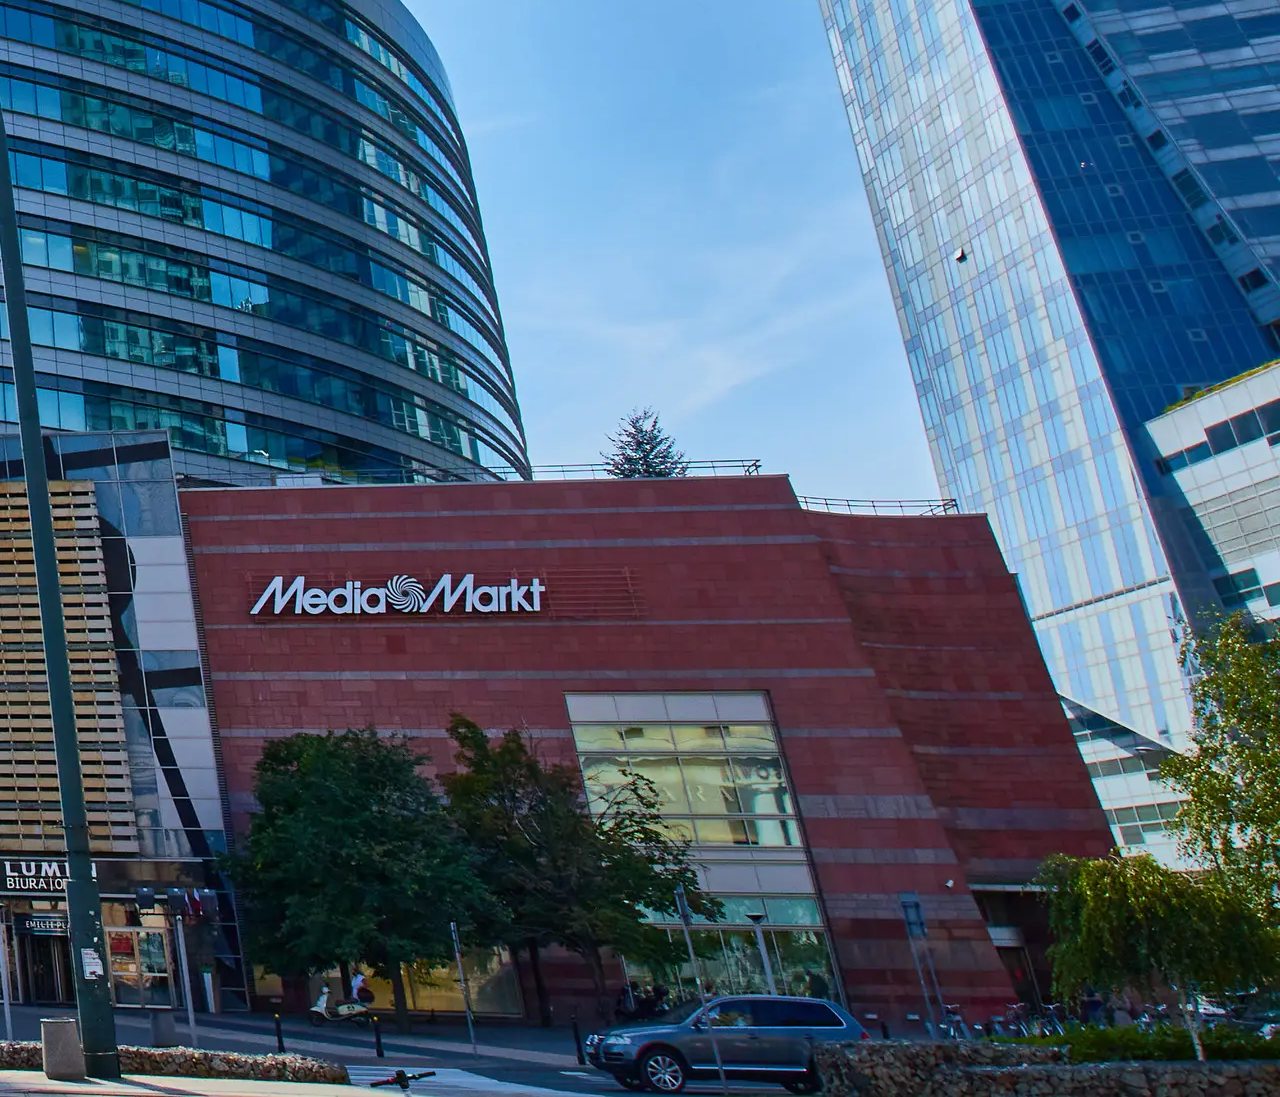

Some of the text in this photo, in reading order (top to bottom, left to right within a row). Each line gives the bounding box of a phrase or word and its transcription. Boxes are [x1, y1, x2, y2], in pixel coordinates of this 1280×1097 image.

[250, 574, 545, 614] Media Markt
[6, 878, 47, 890] BIURA
